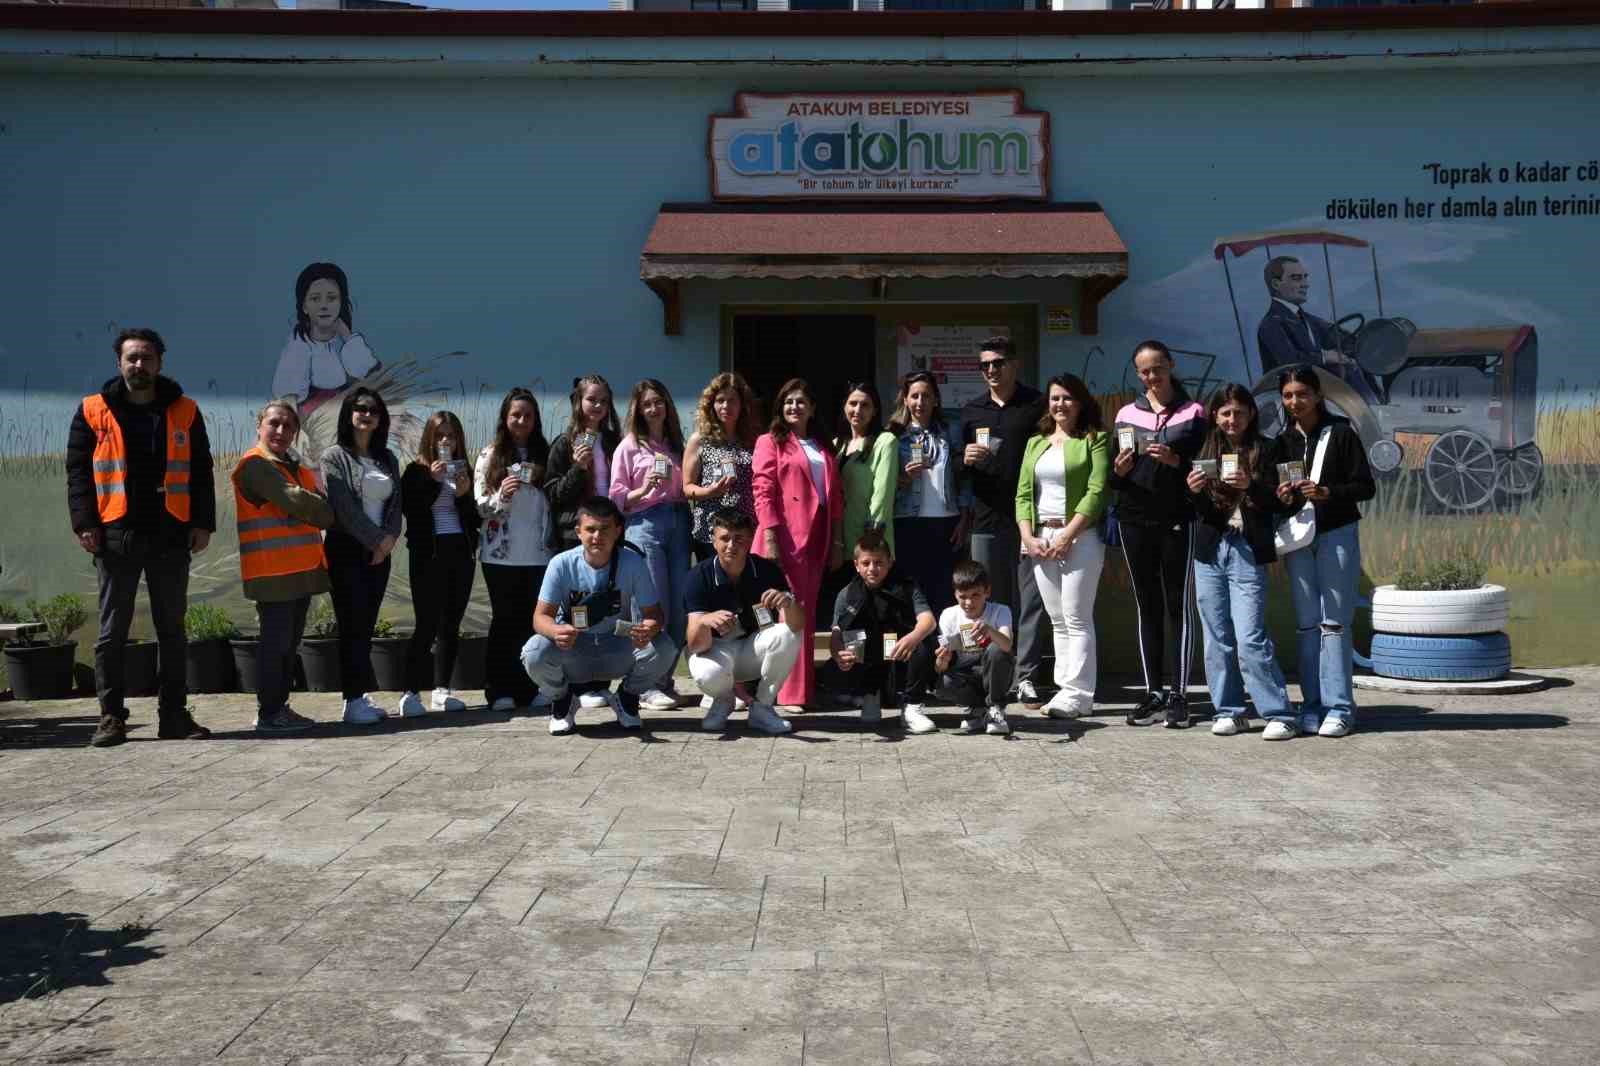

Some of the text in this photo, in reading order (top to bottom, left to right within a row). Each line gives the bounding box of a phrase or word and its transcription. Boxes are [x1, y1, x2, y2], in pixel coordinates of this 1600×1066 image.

[787, 102, 863, 117] ATAKUM
[732, 119, 1028, 171] atatohum
[1499, 167, 1509, 183] o
[1515, 160, 1571, 183] kadar
[822, 178, 855, 190] tohum
[876, 177, 908, 192] ülkeyi
[1326, 197, 1398, 220] dökülen
[1404, 196, 1435, 218] her
[1441, 195, 1498, 218] damla
[1504, 195, 1537, 217] alın
